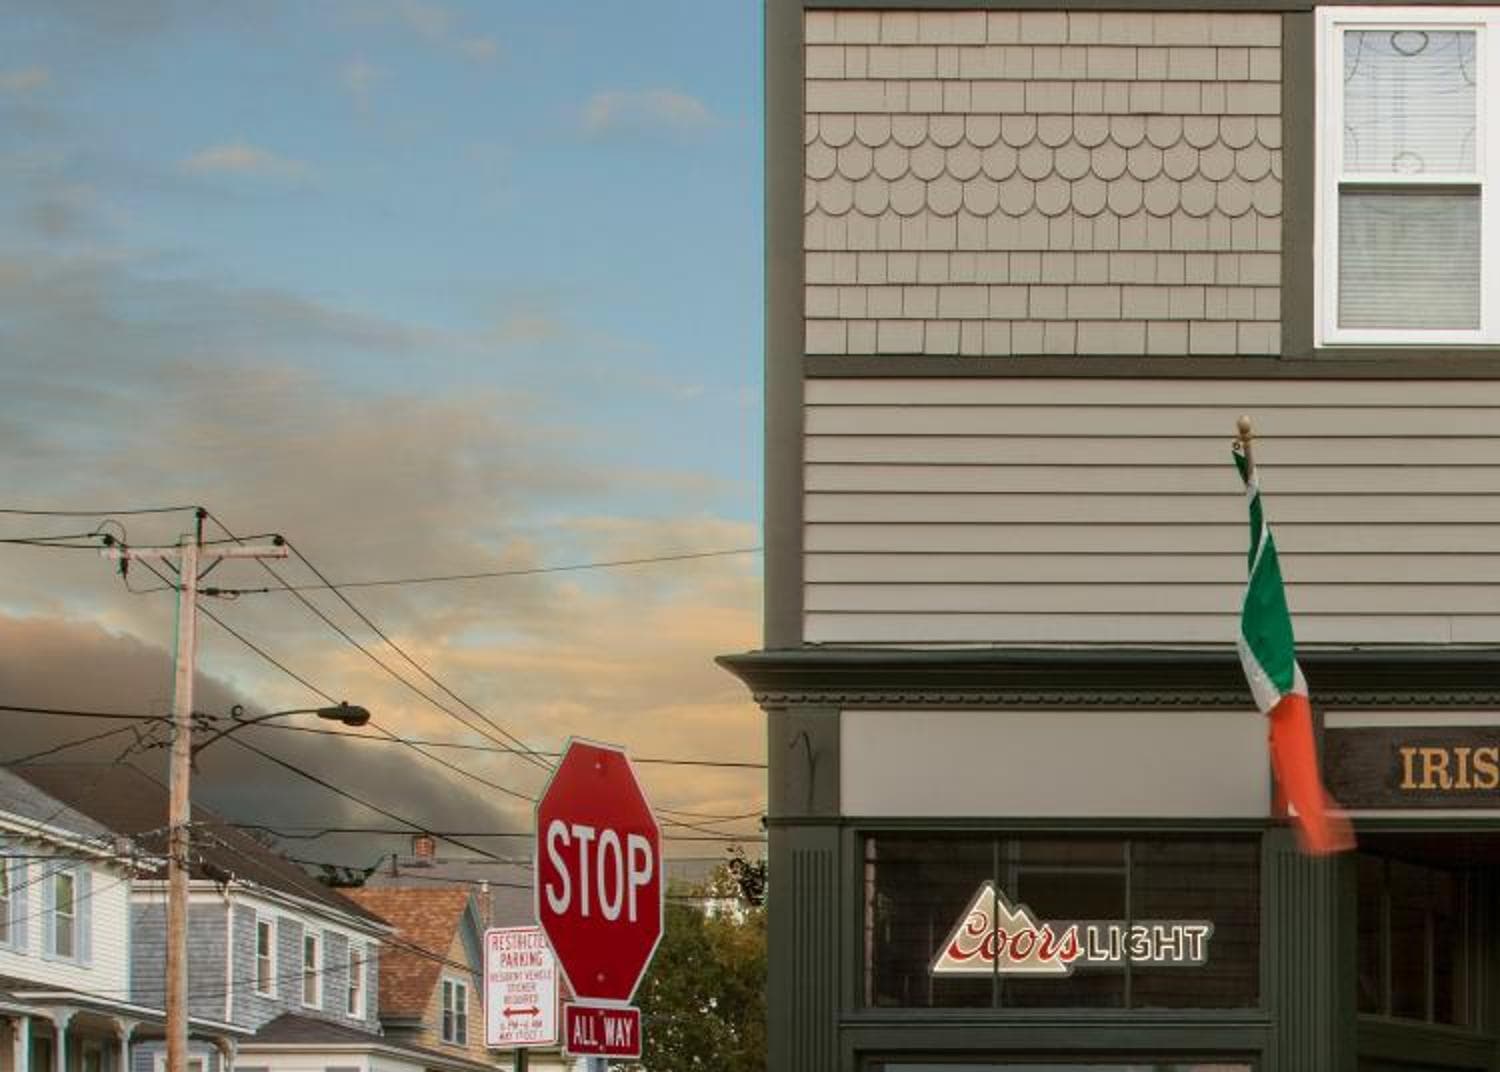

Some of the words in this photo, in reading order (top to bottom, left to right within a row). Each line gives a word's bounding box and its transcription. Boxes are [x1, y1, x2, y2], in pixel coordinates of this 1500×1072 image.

[545, 819, 653, 922] STOP
[491, 933, 549, 950] RESTRICTE
[948, 911, 1084, 962] Coors
[1087, 925, 1209, 962] LIGHT
[501, 951, 543, 967] PARKING
[573, 1015, 598, 1046] ALL
[603, 1016, 633, 1047] WAY
